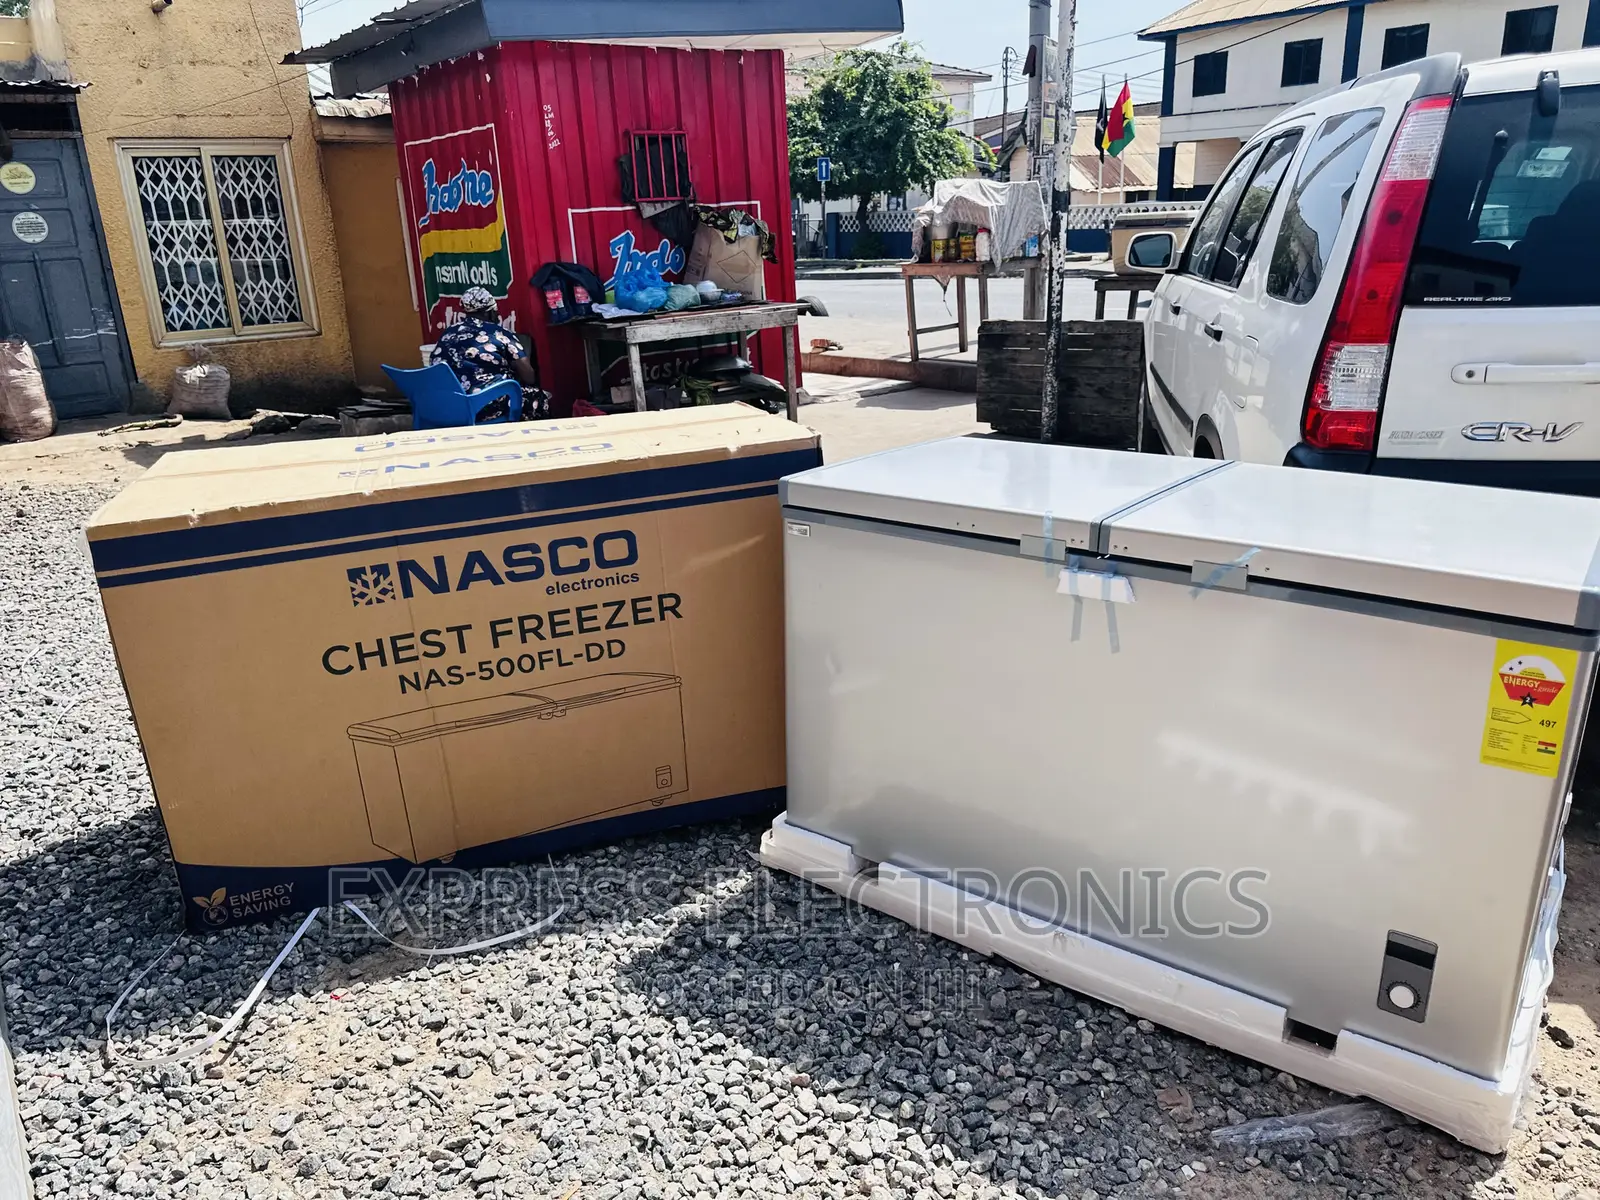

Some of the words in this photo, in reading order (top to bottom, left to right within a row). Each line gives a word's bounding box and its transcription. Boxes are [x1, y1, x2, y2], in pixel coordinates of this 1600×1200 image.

[603, 229, 686, 291] Indo
[355, 426, 559, 452] NASCO
[1461, 421, 1584, 442] CR-V
[384, 442, 613, 473] NASCO
[396, 529, 639, 600] NASCO
[545, 572, 640, 596] electronics
[321, 624, 473, 676] CHEST
[489, 592, 684, 650] FREEZER
[398, 639, 627, 695] NAS-500FL-DD
[1503, 676, 1541, 689] ENERGY
[1539, 719, 1557, 729] 497
[229, 882, 295, 906] ENERGY
[232, 896, 292, 918] SAVING
